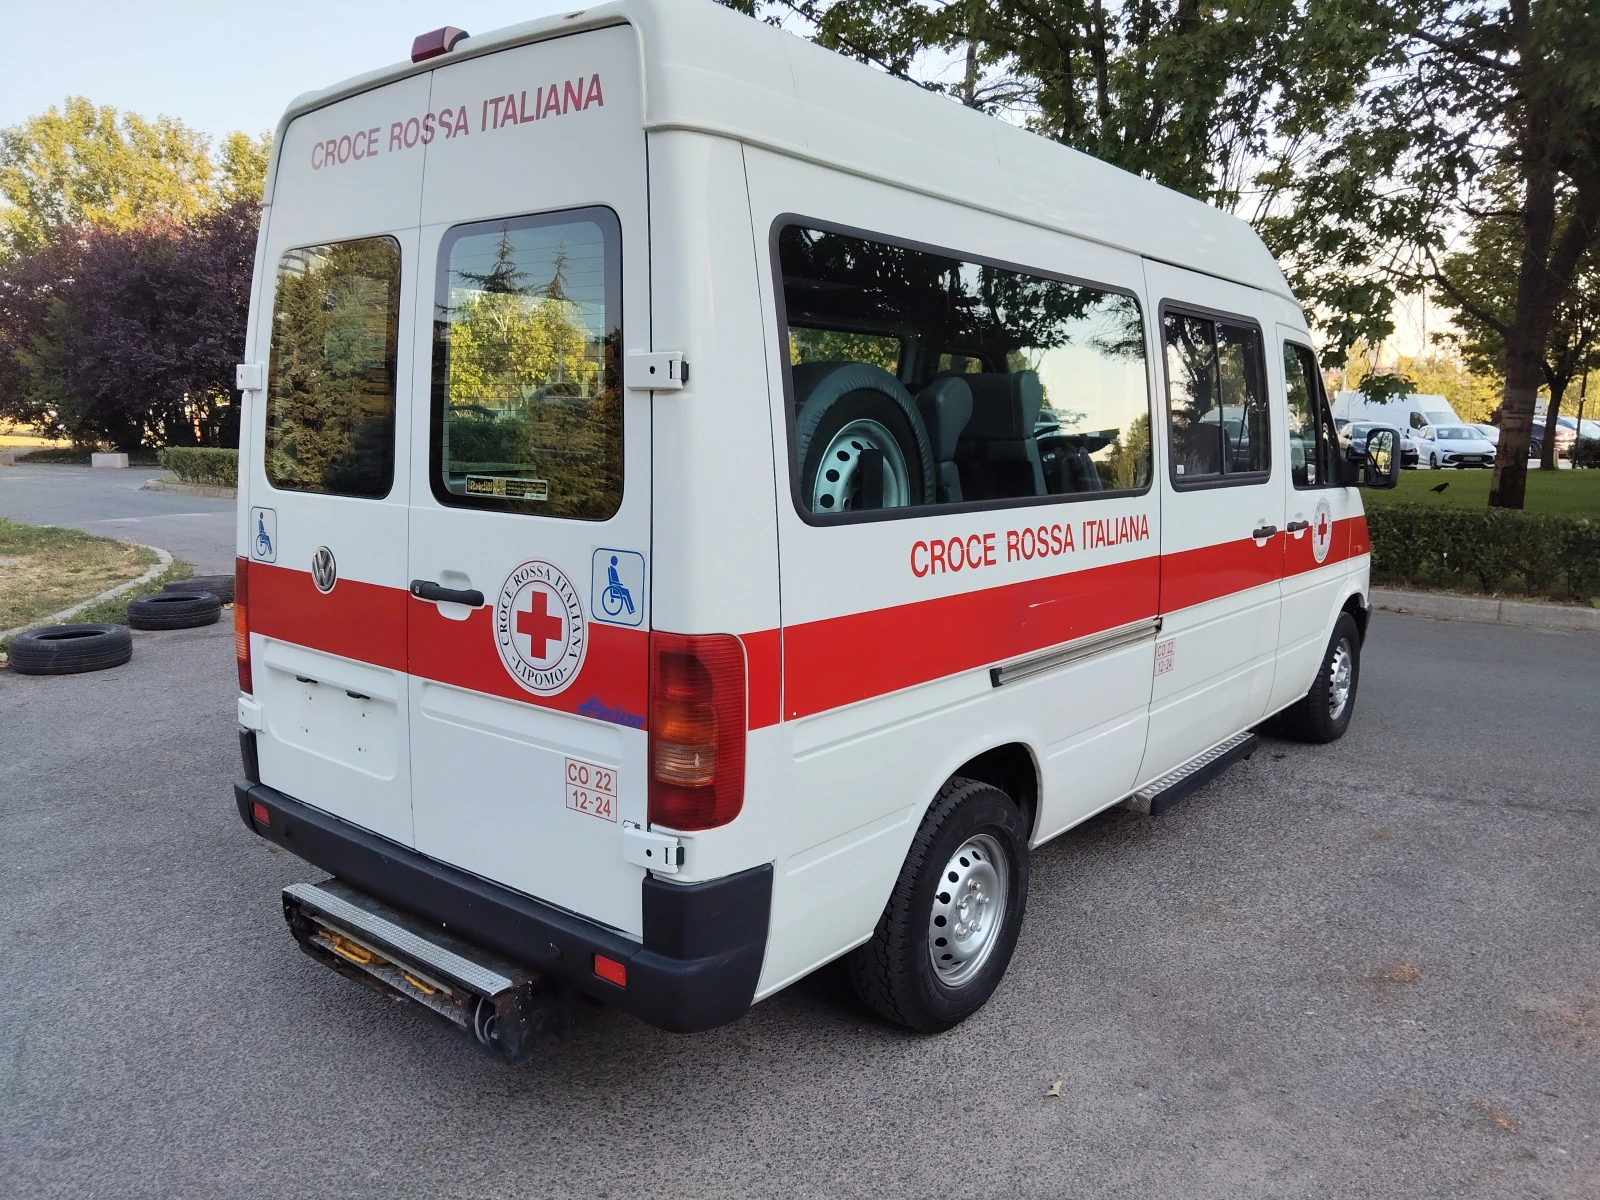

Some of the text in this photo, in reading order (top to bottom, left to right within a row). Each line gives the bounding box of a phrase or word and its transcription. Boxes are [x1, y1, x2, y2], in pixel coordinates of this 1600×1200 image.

[310, 73, 604, 170] CROCE ROSSA ITALIANA
[910, 514, 1150, 578] CROCE ROSSA ITALIANA
[499, 564, 582, 658] CROCE ROSSA ITALIANA
[568, 763, 612, 792] CO 22
[572, 789, 612, 817] 12-24
